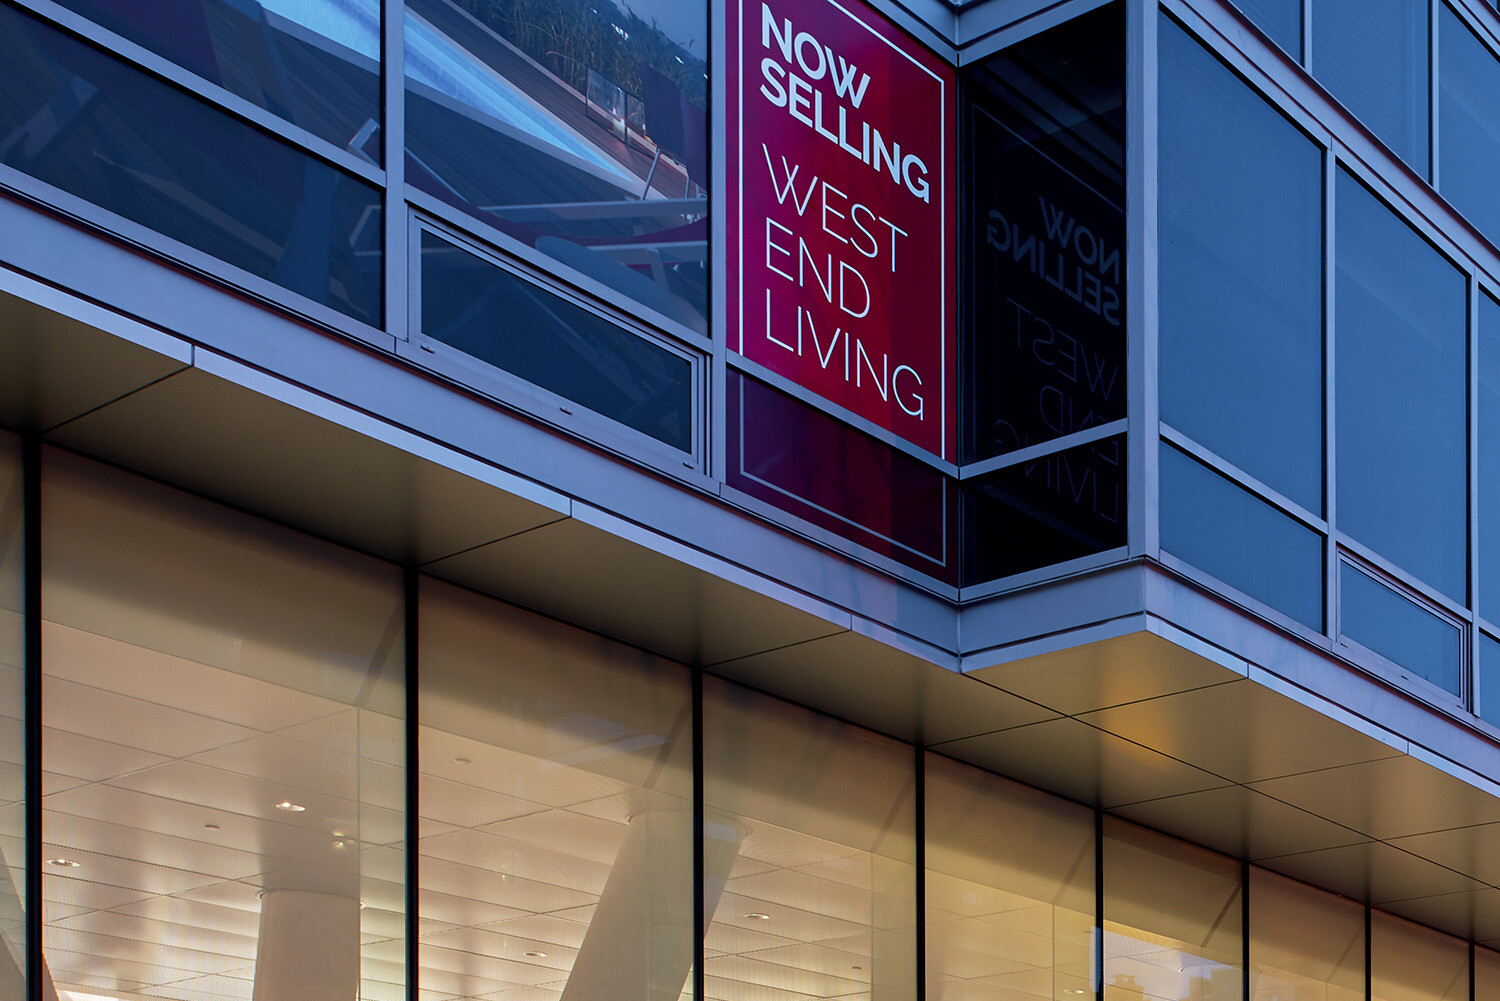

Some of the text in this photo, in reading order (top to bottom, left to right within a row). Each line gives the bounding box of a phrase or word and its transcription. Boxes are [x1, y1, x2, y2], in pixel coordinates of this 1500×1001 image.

[762, 2, 871, 109] NOW
[760, 57, 930, 204] SELLING
[762, 142, 908, 273] WEST
[766, 217, 871, 319] END
[766, 288, 924, 421] LIVING
